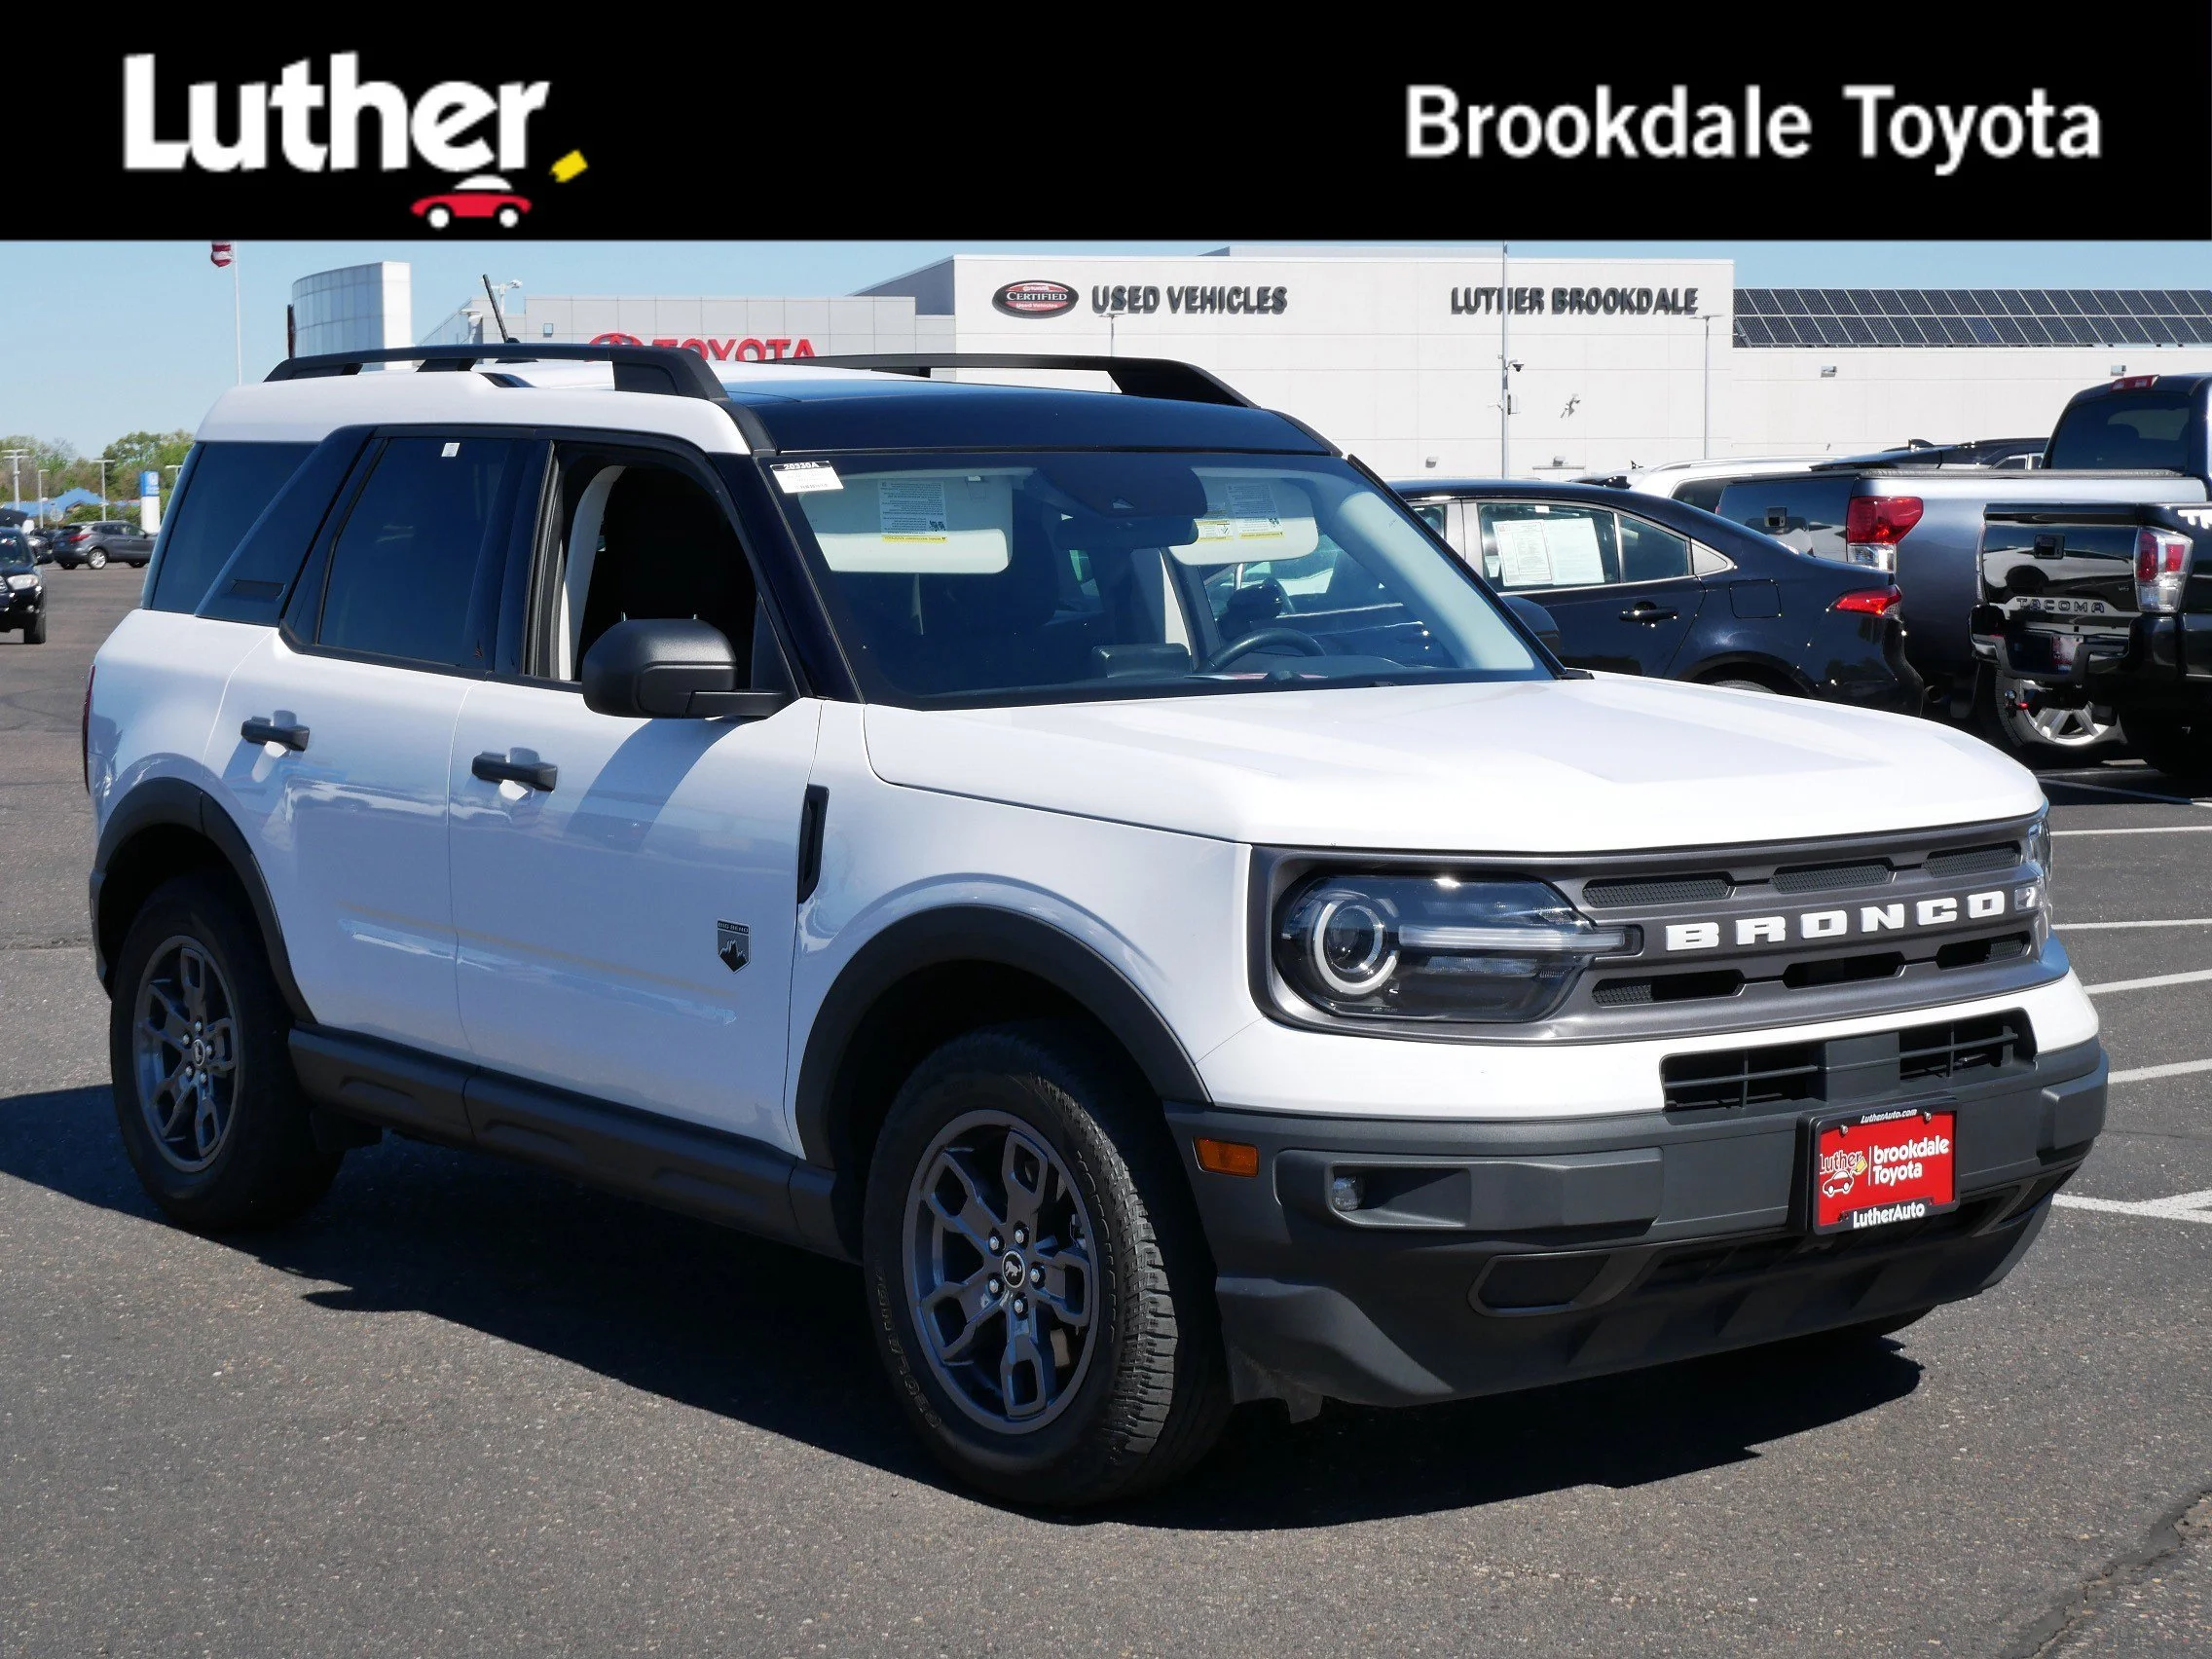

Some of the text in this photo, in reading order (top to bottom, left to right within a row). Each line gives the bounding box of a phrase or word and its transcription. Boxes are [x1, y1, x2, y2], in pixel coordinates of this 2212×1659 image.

[1006, 291, 1068, 301] CERTIFIED
[1091, 284, 1288, 315] USED VEHICLES
[1451, 286, 1699, 315] LUTHER BROOKDALE
[2016, 597, 2105, 613] TACOMA
[1665, 890, 2006, 952] BRONCO
[1861, 1108, 1918, 1124] LutherAuto.com
[1873, 1135, 1950, 1164] brookdale
[1872, 1160, 1923, 1186] Toyota
[1853, 1201, 1925, 1229] LutherAuto
